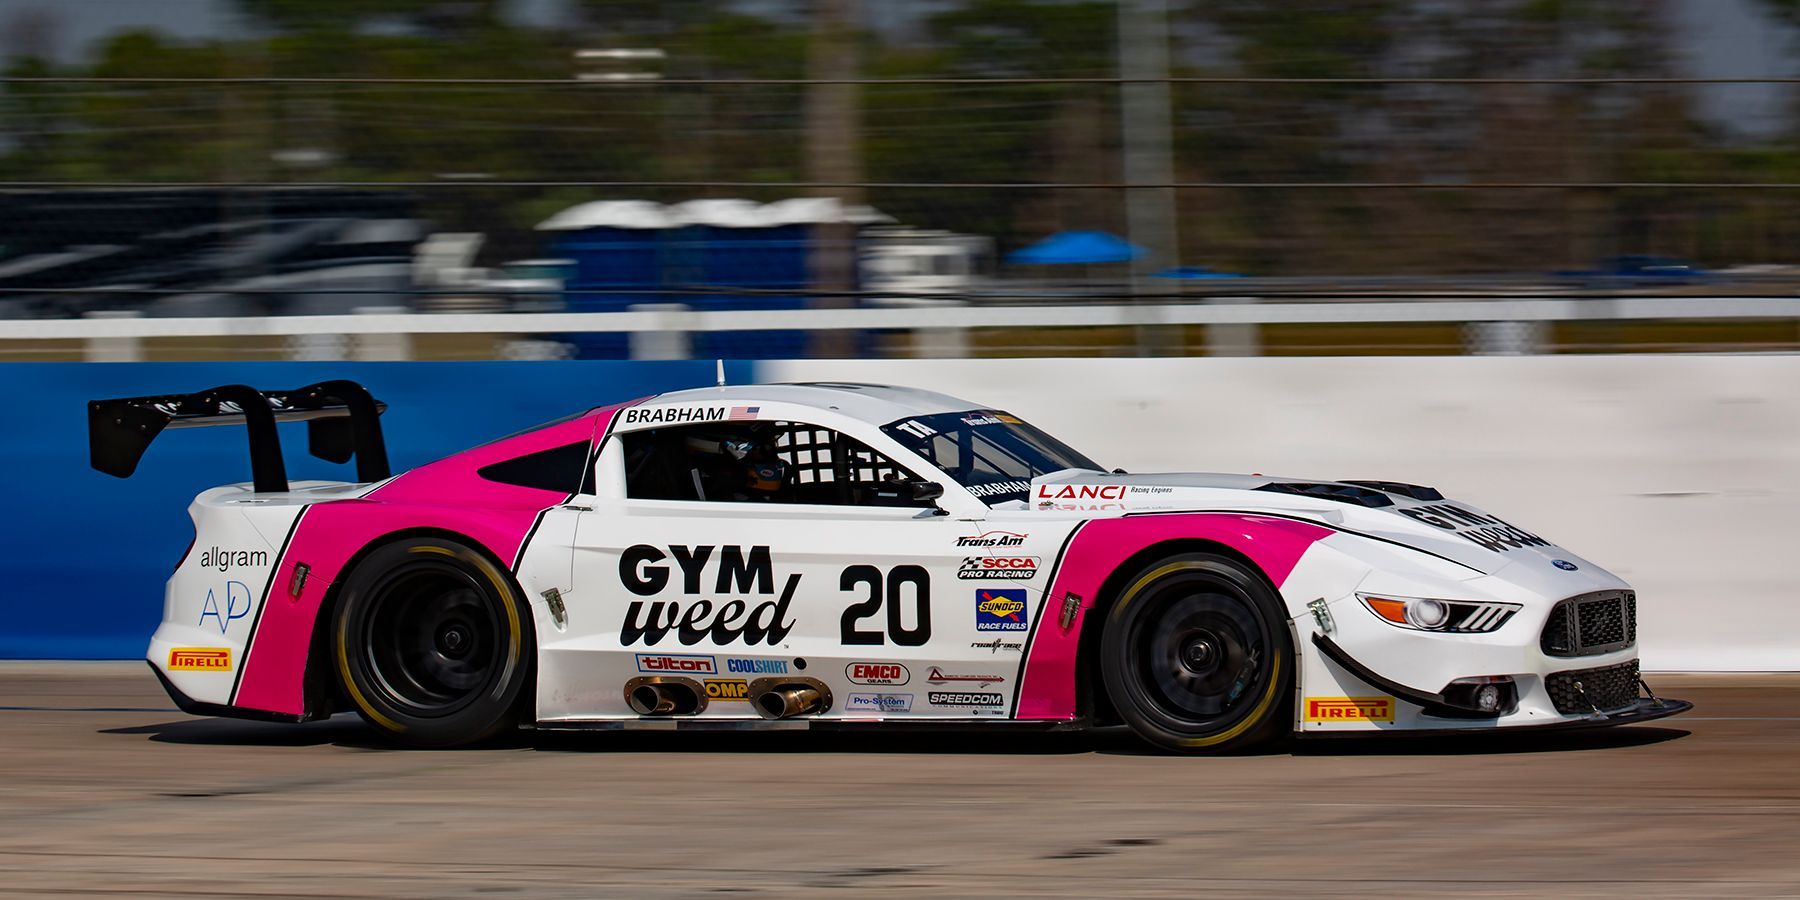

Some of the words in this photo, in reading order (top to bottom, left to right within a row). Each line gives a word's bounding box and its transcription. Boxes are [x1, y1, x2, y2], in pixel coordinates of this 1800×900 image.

[626, 407, 725, 423] BRABHAM
[896, 420, 938, 439] TA
[966, 480, 1031, 498] BRABHAM
[1038, 484, 1127, 500] LANCI
[1130, 486, 1149, 494] Racing
[1150, 486, 1173, 494] Engines
[1397, 504, 1498, 530] GYM
[956, 536, 997, 547] Trans
[997, 535, 1024, 546] Am
[200, 546, 268, 572] allgram
[982, 558, 1036, 569] SCCA
[619, 544, 775, 596] GYM
[959, 570, 984, 578] PRO
[986, 570, 1034, 578] RACING
[619, 573, 803, 647] weed
[839, 564, 931, 646] 20
[980, 602, 1022, 611] SUNOCO
[977, 622, 1001, 630] RACE
[1002, 622, 1027, 630] FUELS
[170, 651, 228, 668] PIRELLI
[642, 657, 712, 671] tilton
[853, 664, 901, 679] EMCO
[705, 682, 748, 698] OMP
[854, 697, 905, 706] Pro-System
[930, 694, 1002, 704] SPEEDCOM
[1309, 700, 1389, 718] PIRELLI
